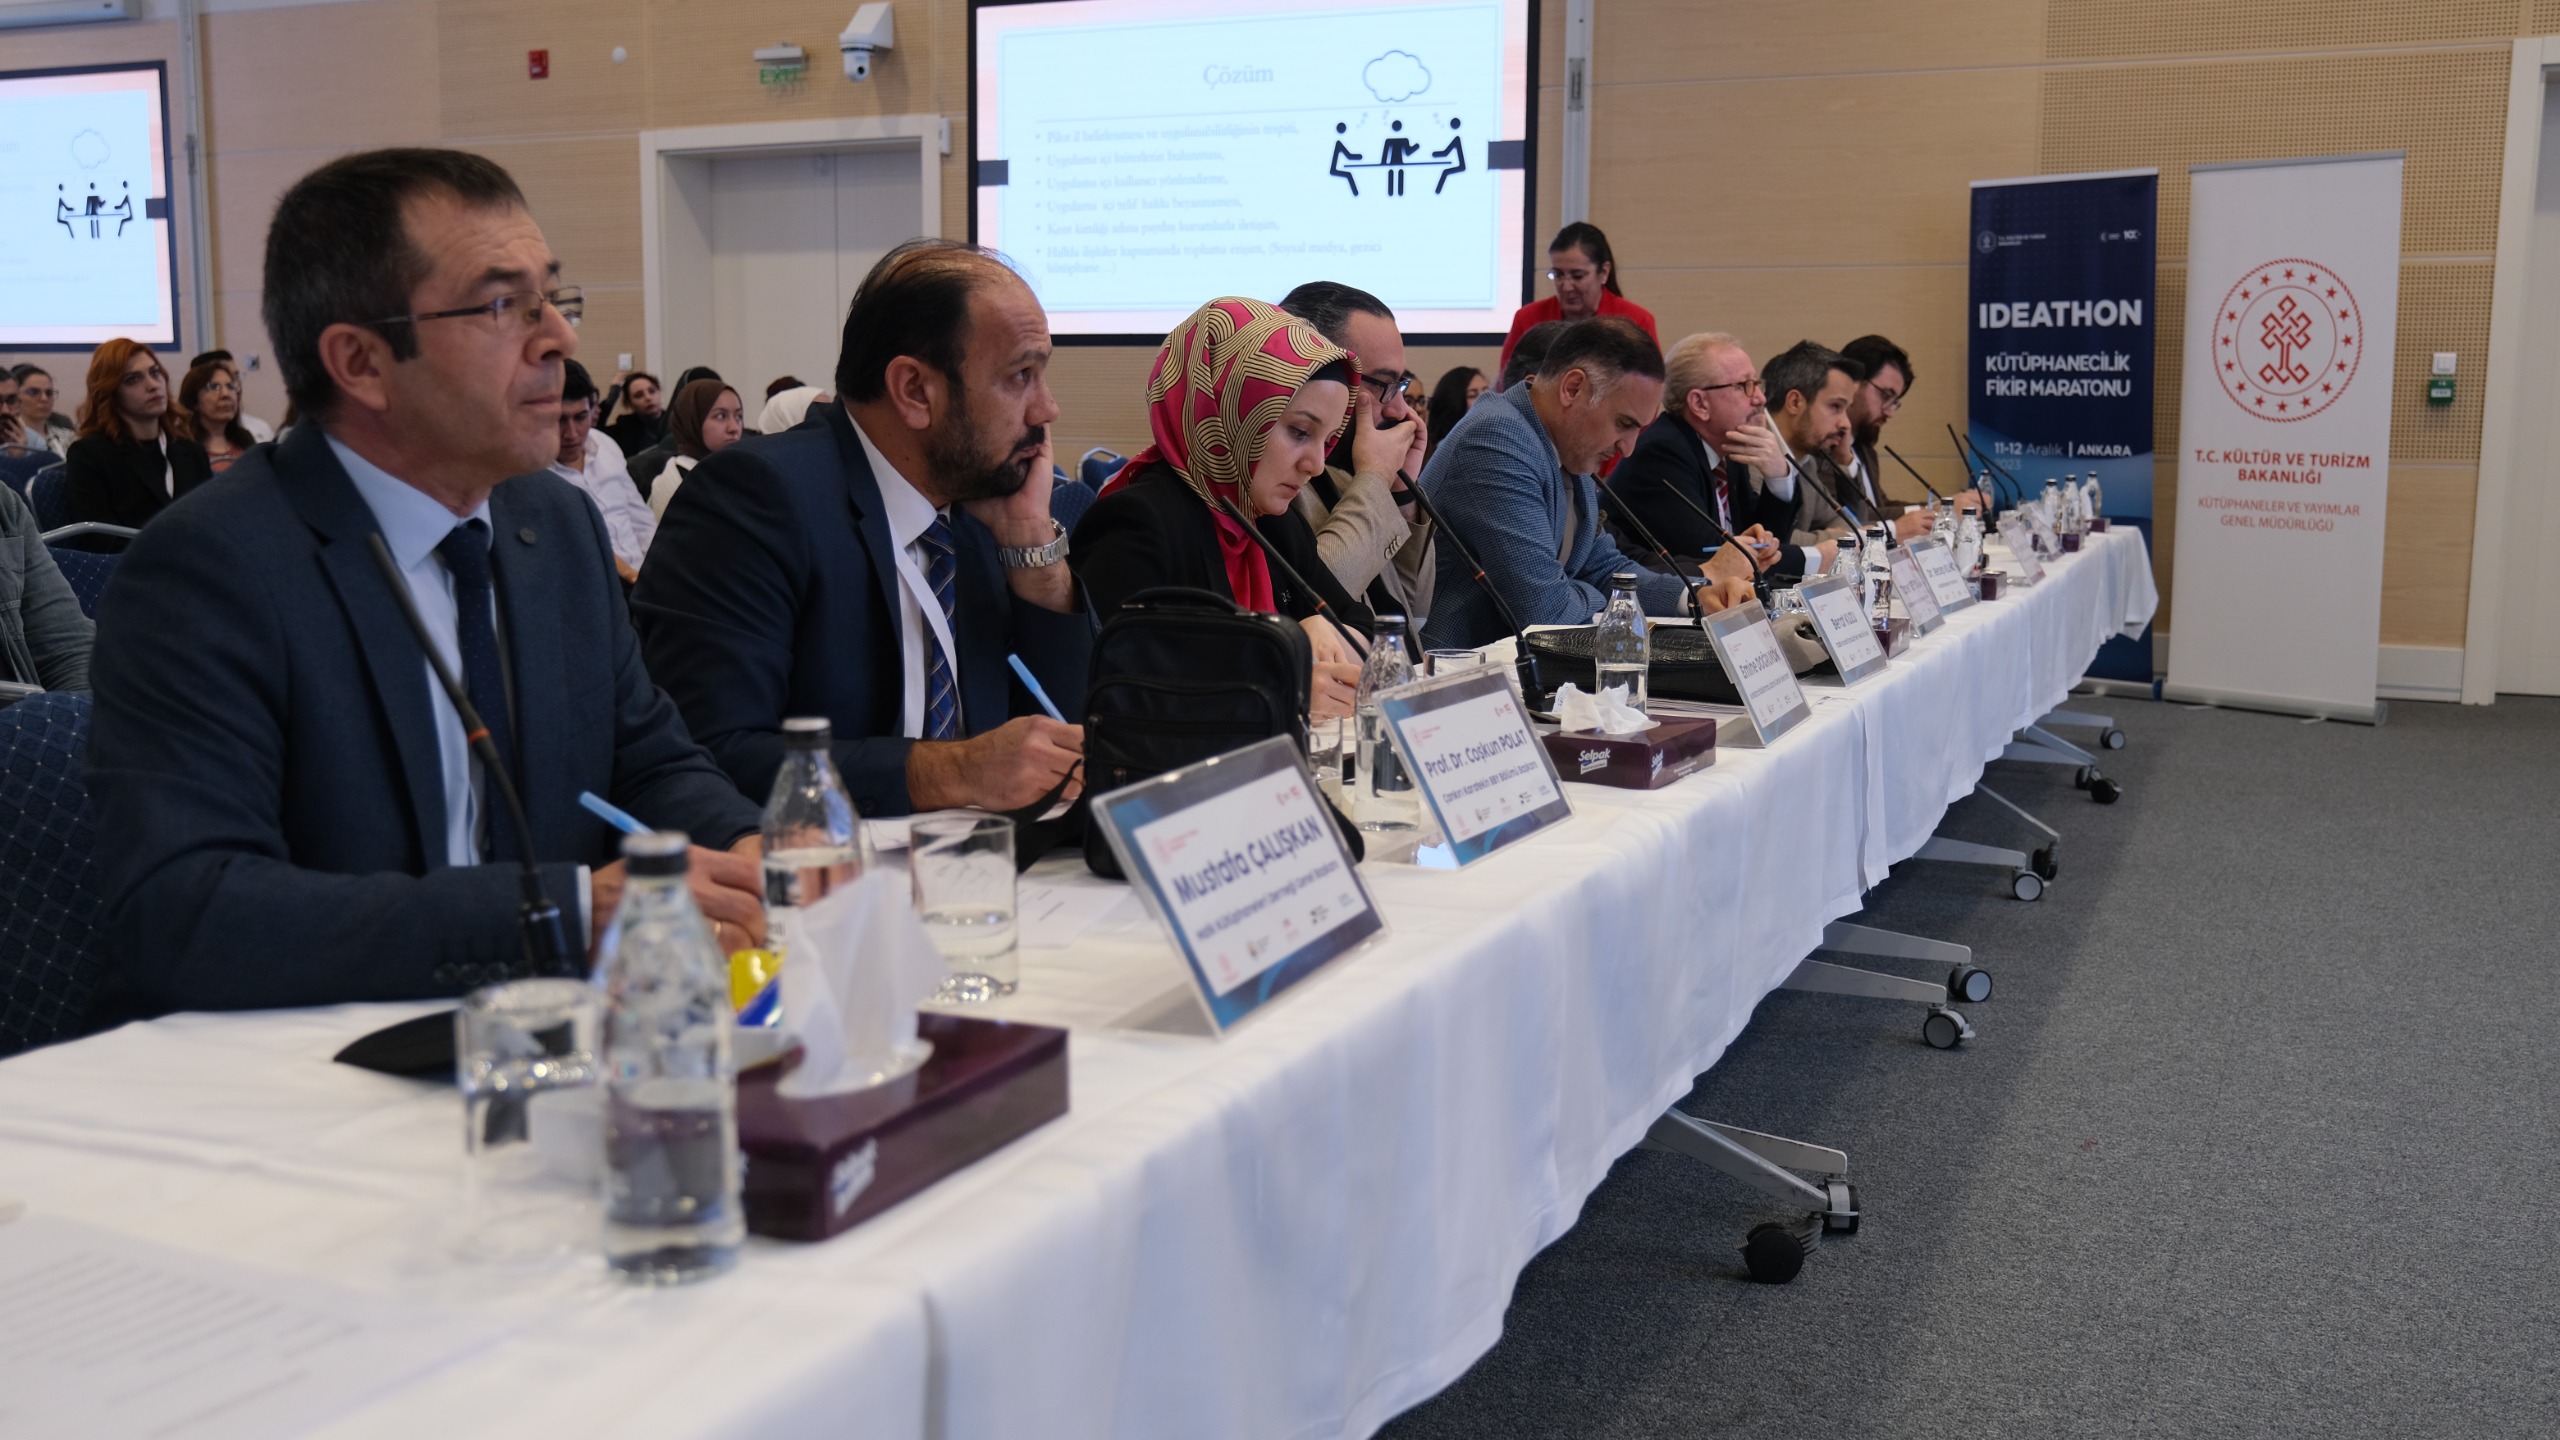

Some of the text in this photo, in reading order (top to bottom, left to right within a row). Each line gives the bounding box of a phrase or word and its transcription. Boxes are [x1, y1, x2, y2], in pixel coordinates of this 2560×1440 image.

[1203, 64, 1274, 90] Çözüm
[1979, 299, 2143, 329] IDEATHON
[1986, 350, 2131, 372] KÜTÜPHANECİLİK
[1986, 375, 2131, 397] FİKİR MARATONU
[1994, 441, 2132, 456] 11-12 Aralık ANKARA
[2195, 447, 2370, 468] T.C. KÜLTÜR VE TURİZM
[2238, 468, 2321, 484] BAKANLIĞI
[2198, 495, 2360, 516] KÜTÜPHANELER VE YAYIMLAR
[2220, 514, 2334, 532] GENEL MÜDÜRLÜĞÜ
[1423, 728, 1529, 779] Prof. Dr. Coşkun POLAT
[1578, 747, 1611, 762] Selpak
[1172, 847, 1250, 906] Mustafa
[1247, 813, 1324, 877] ÇALIŞKAN
